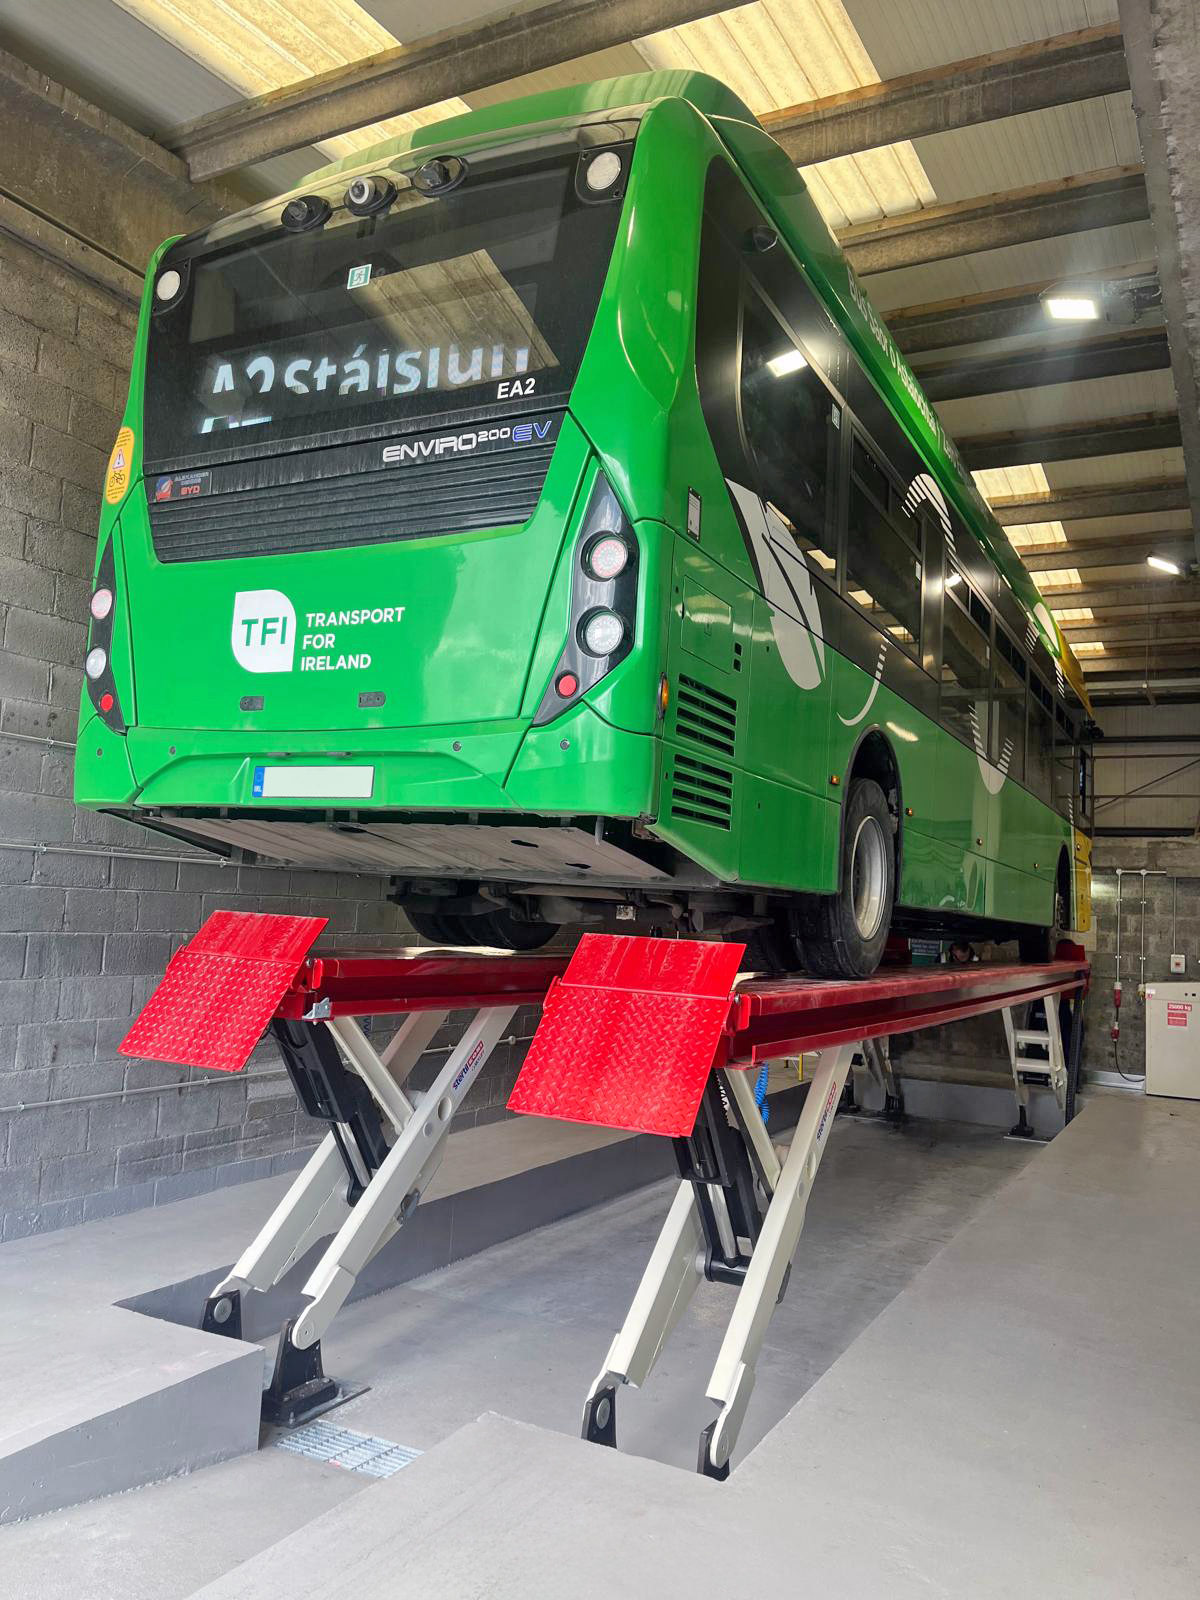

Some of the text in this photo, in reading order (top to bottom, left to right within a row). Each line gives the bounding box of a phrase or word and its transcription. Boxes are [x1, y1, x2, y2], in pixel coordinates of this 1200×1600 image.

[497, 377, 536, 400] EA2
[512, 420, 552, 443] EV
[181, 485, 200, 495] BYD
[305, 606, 406, 628] TRANSPORT
[241, 616, 288, 647] TFI
[302, 633, 336, 650] FOR
[300, 653, 372, 671] IRELAND
